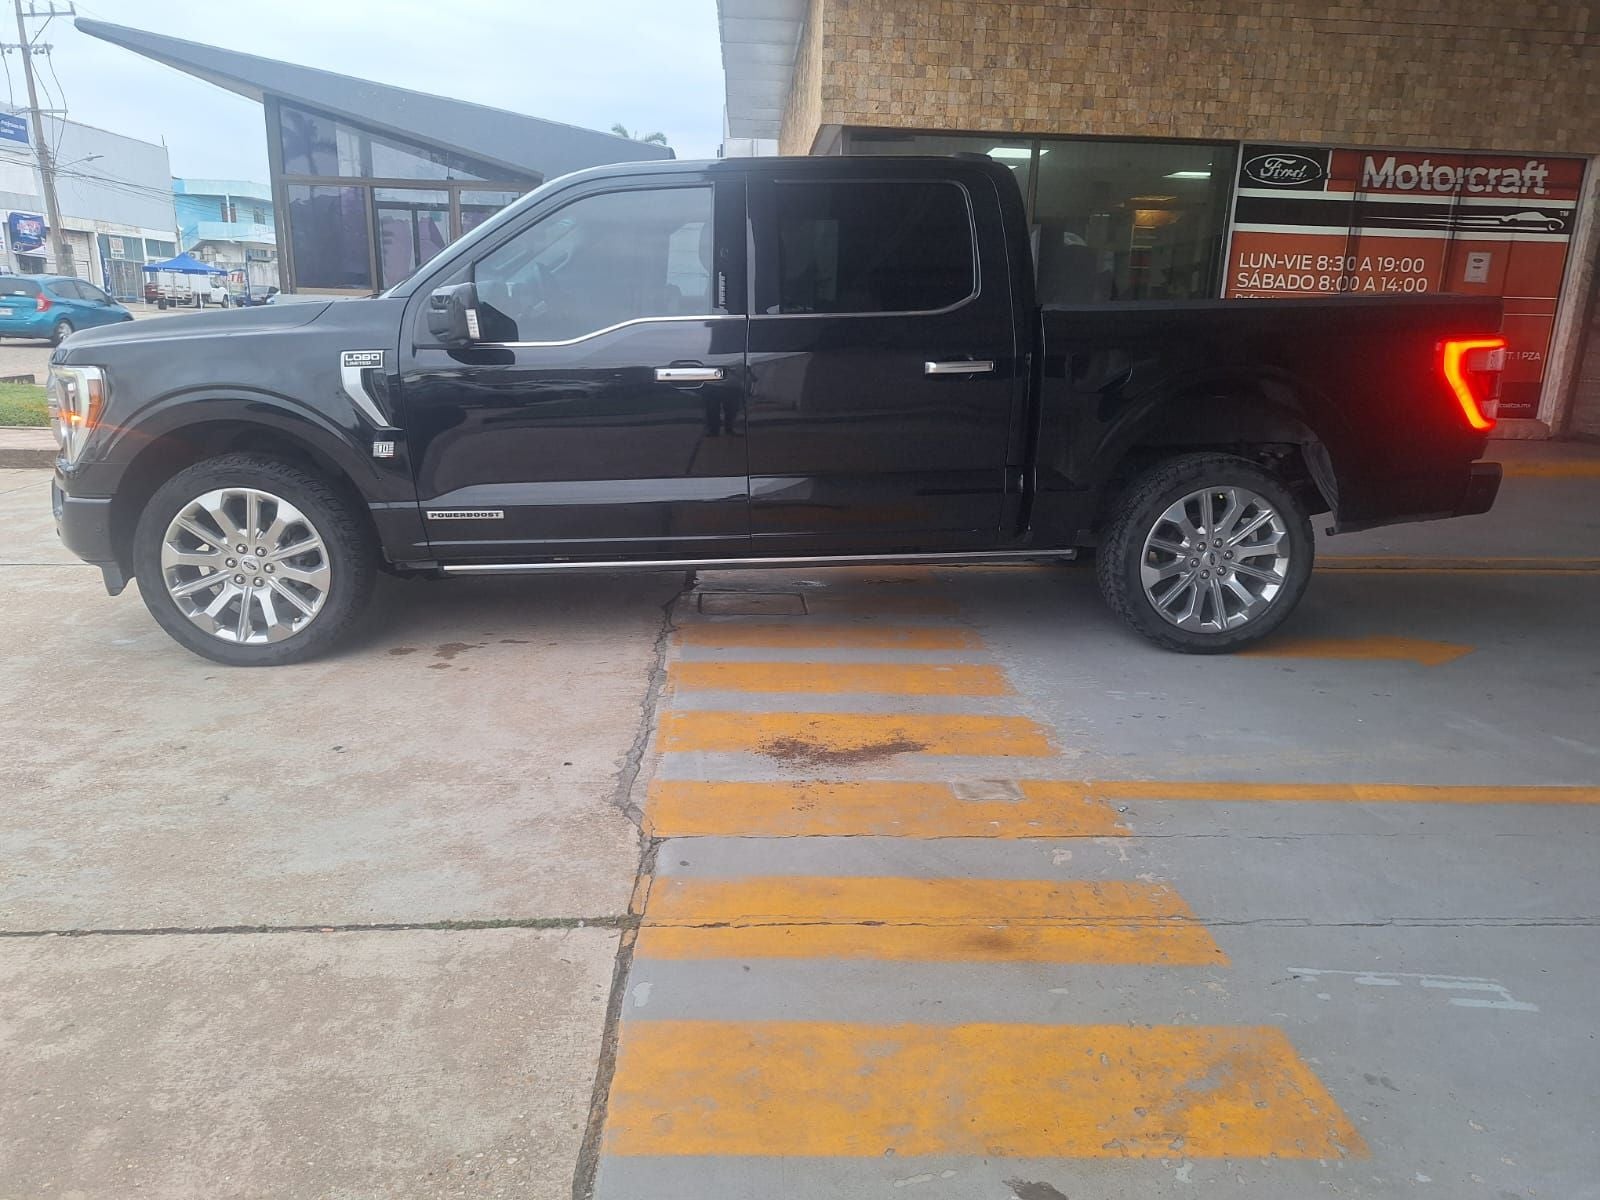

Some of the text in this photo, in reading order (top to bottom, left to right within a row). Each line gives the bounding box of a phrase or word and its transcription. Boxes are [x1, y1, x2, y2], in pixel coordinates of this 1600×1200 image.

[1361, 155, 1549, 195] Motorcraft
[1239, 252, 1425, 273] LUN-VIE 8:30 A 19:00
[1236, 269, 1428, 293] SÁBADO 8:00 A 14:00
